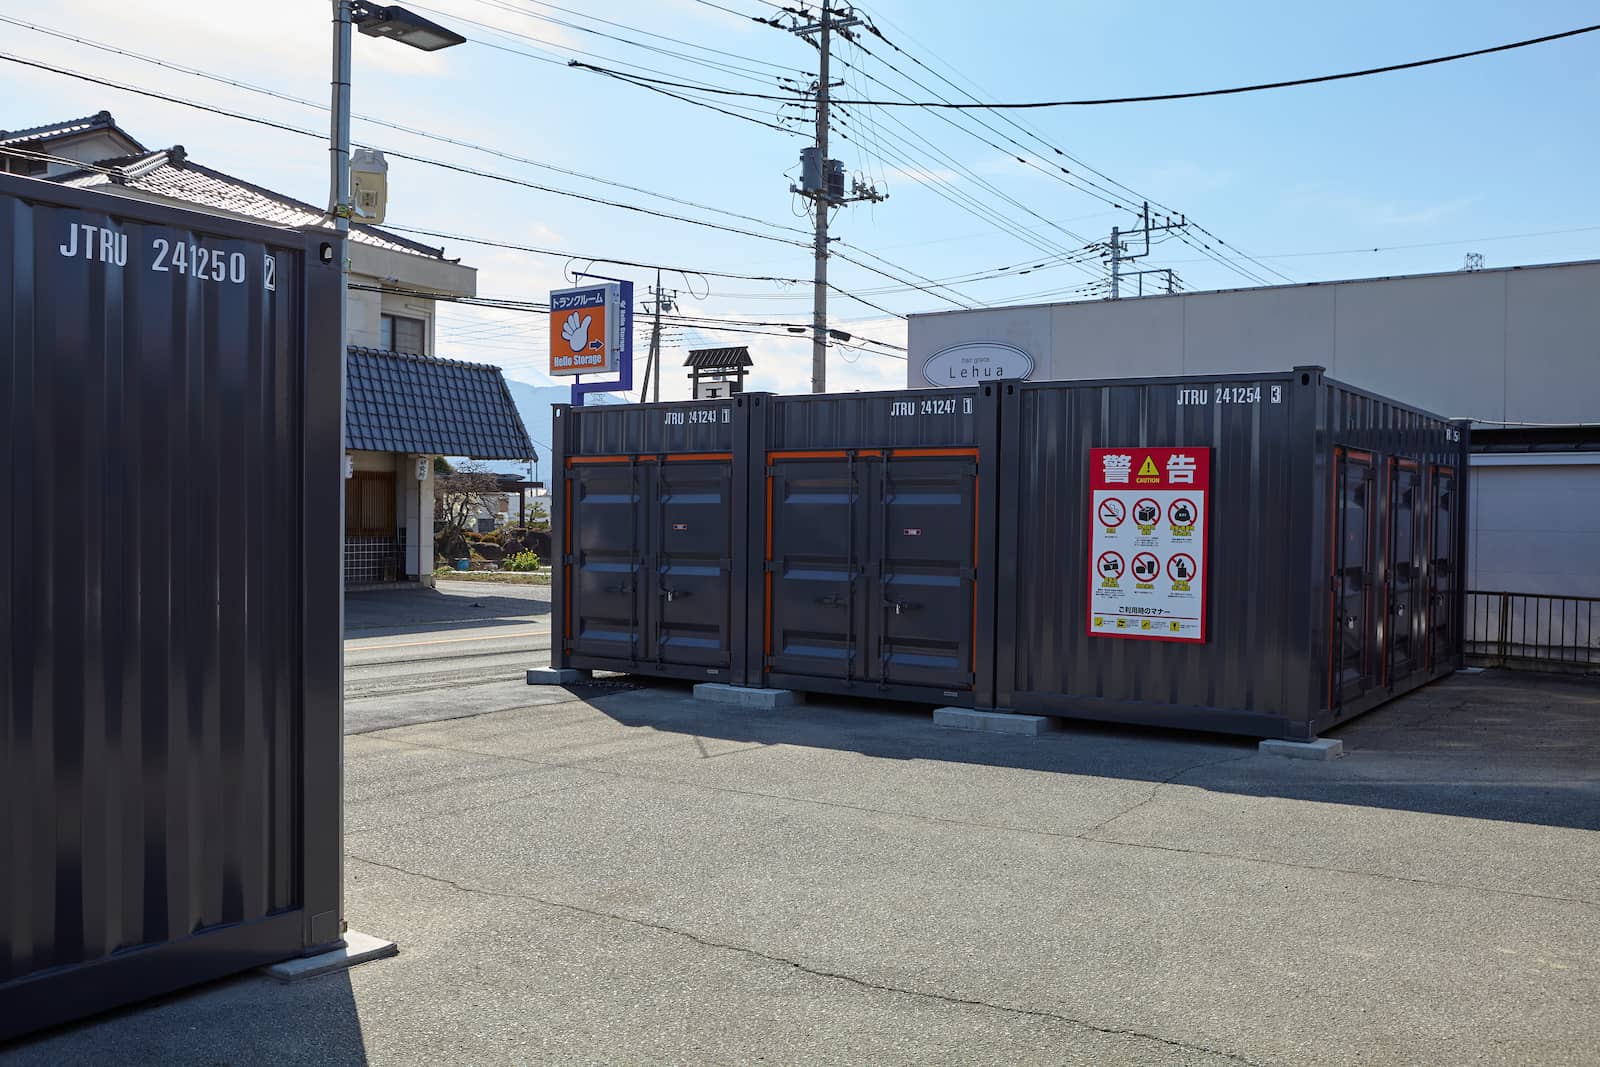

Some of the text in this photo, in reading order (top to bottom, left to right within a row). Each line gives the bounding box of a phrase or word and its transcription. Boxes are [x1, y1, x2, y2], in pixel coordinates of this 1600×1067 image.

[60, 222, 276, 291] JTRU 241250 2
[553, 292, 603, 309] トランクルーム
[554, 354, 602, 368] Hello Storage
[949, 365, 1004, 379] Lehua
[1177, 386, 1281, 405] JTRU 241254 3
[890, 398, 973, 416] JTRU 241247 1
[664, 412, 684, 425] JTRU
[1103, 454, 1196, 484] 警 告
